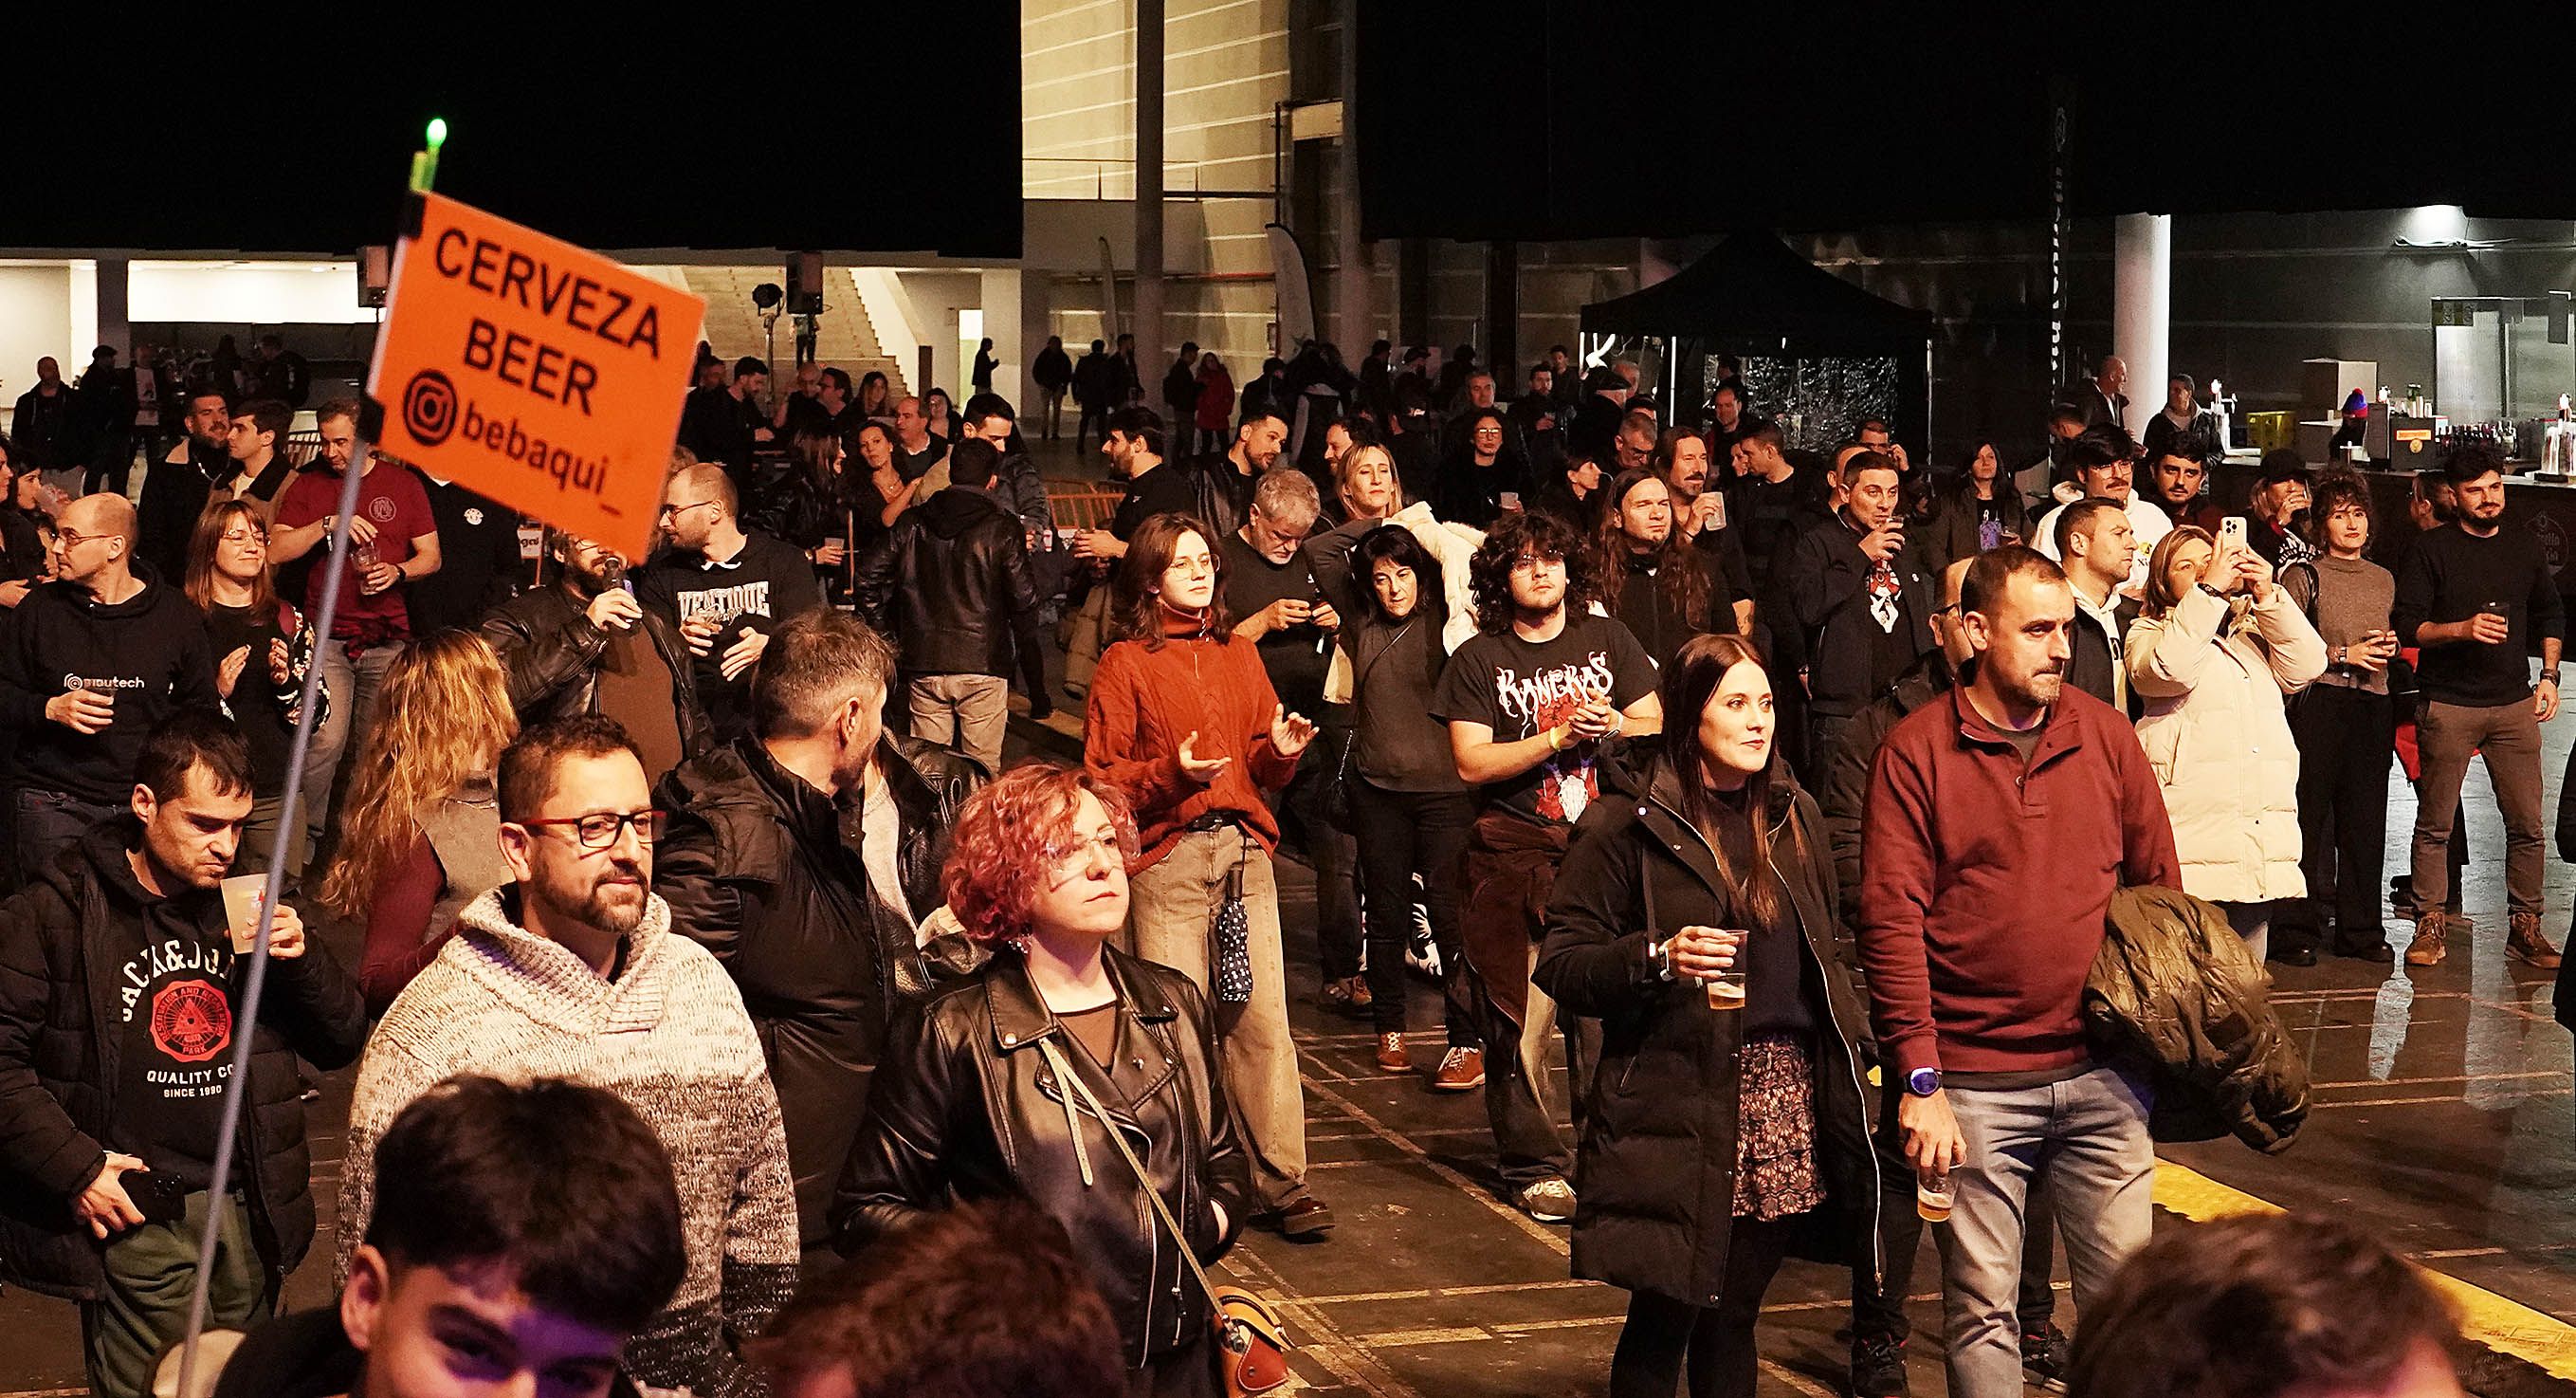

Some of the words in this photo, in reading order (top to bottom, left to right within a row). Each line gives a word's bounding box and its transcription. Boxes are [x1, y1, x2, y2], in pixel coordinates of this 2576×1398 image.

[435, 228, 660, 360] CERVEZA
[464, 317, 599, 417] BEER
[182, 1044, 208, 1055] PARK
[146, 1069, 212, 1085] QUALITY
[163, 1088, 195, 1098] SINCE
[199, 1084, 223, 1096] 1990
